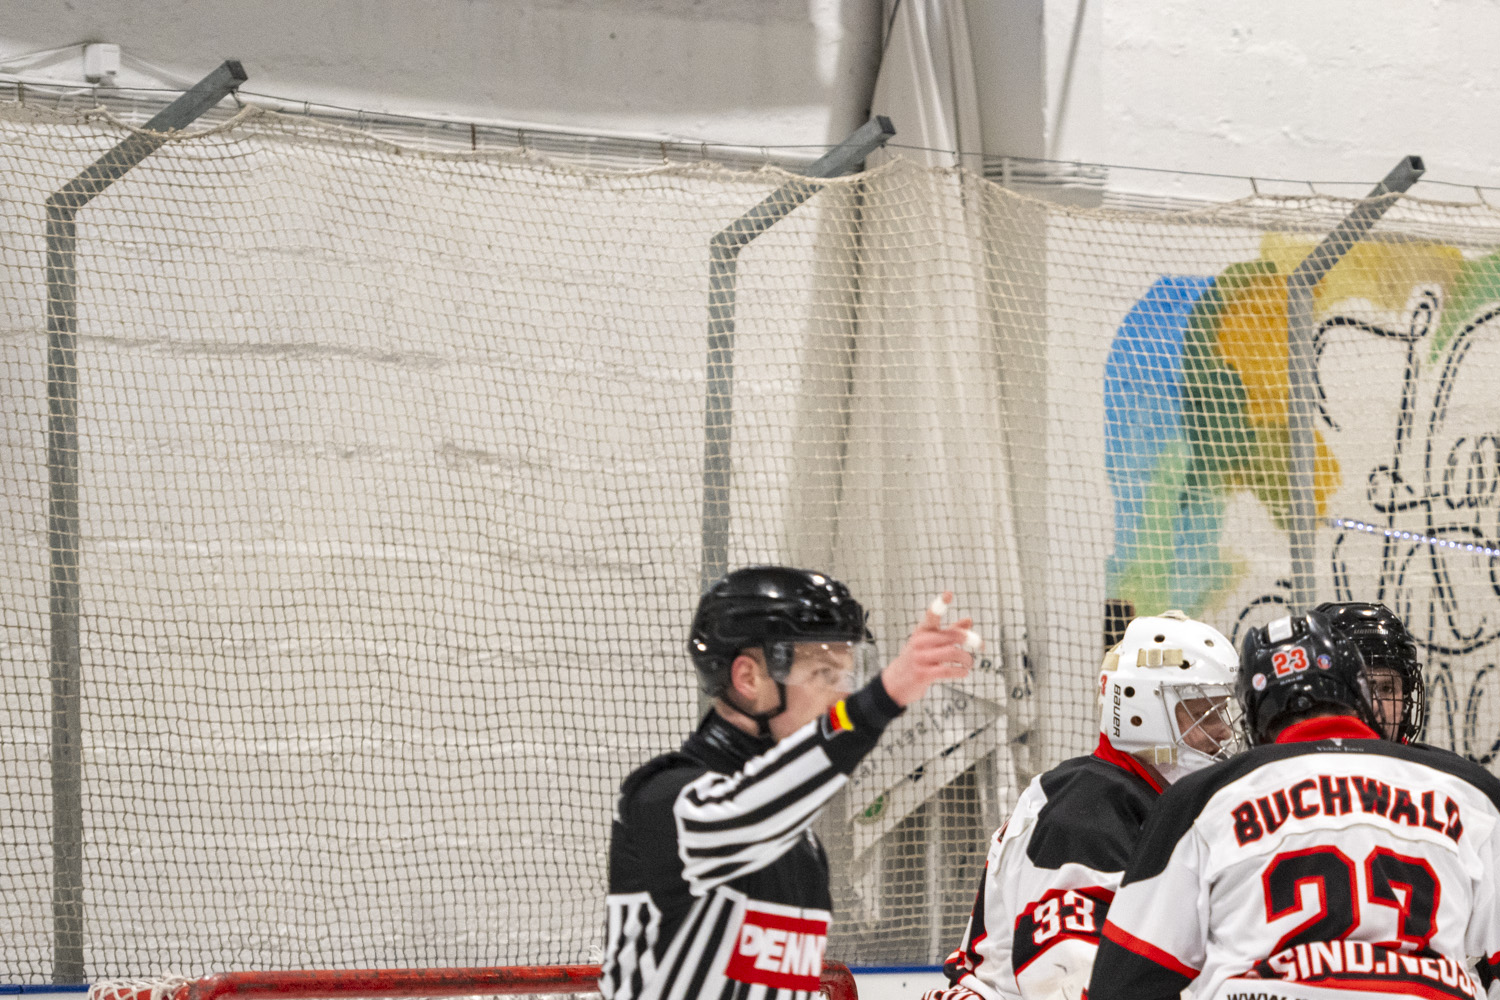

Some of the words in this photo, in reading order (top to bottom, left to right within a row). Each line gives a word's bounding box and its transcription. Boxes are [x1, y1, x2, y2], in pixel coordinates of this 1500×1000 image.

[1272, 647, 1308, 678] 23
[1113, 683, 1121, 738] BAUER
[1231, 775, 1465, 847] BUCHWALD
[1031, 890, 1095, 945] 33
